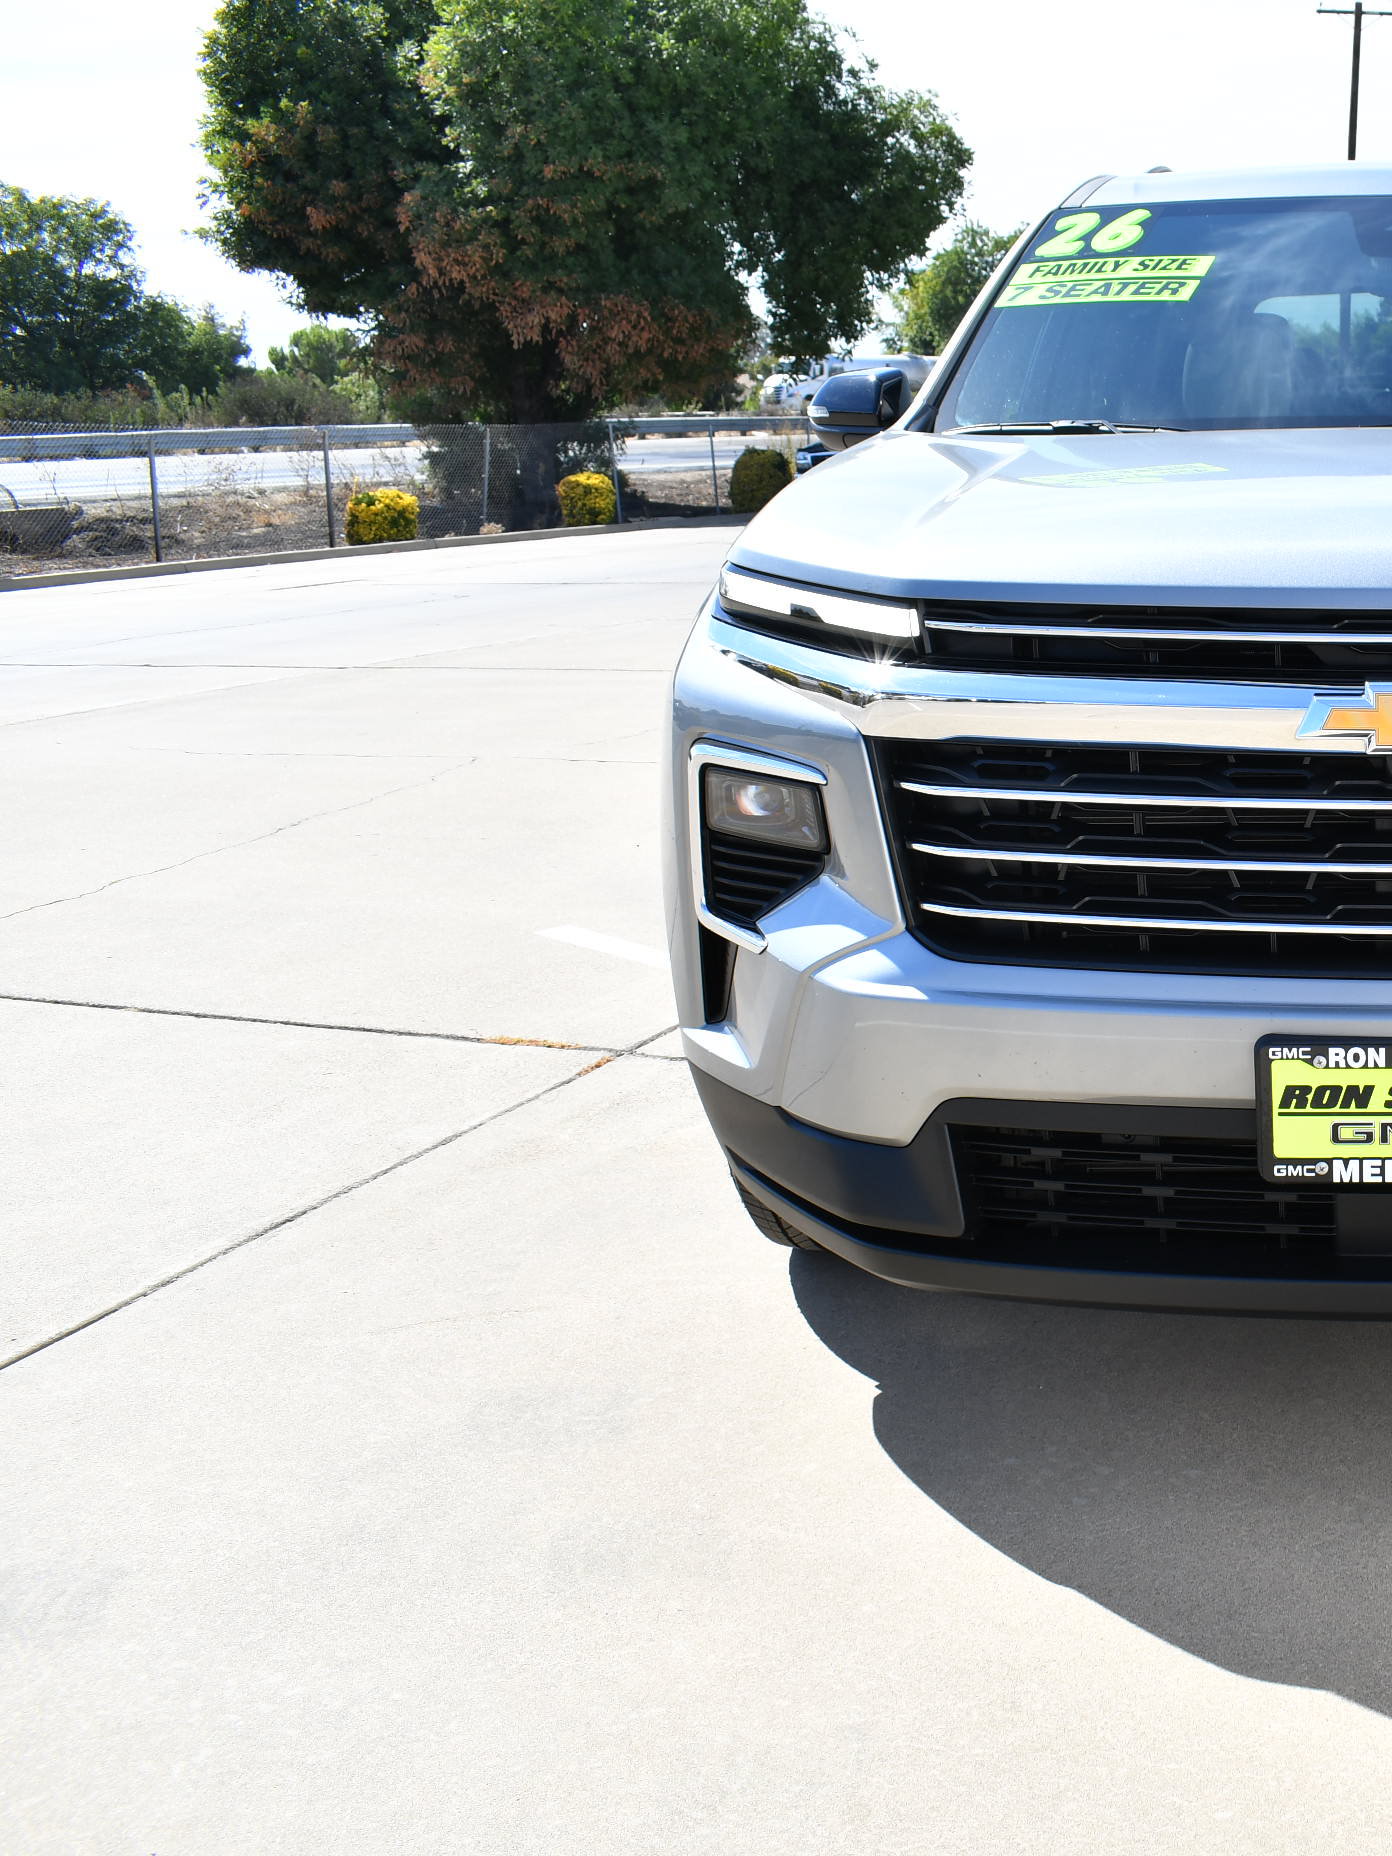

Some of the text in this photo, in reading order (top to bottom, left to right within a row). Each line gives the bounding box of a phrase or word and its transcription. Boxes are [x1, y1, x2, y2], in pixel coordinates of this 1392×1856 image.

[1034, 208, 1152, 258] 26
[1028, 257, 1198, 279] FAMILY SIZE
[1008, 280, 1187, 302] 7 SEATER
[1268, 1047, 1312, 1060] GMC
[1328, 1047, 1386, 1068] RON
[1278, 1084, 1376, 1110] RON
[1273, 1164, 1316, 1177] GMC
